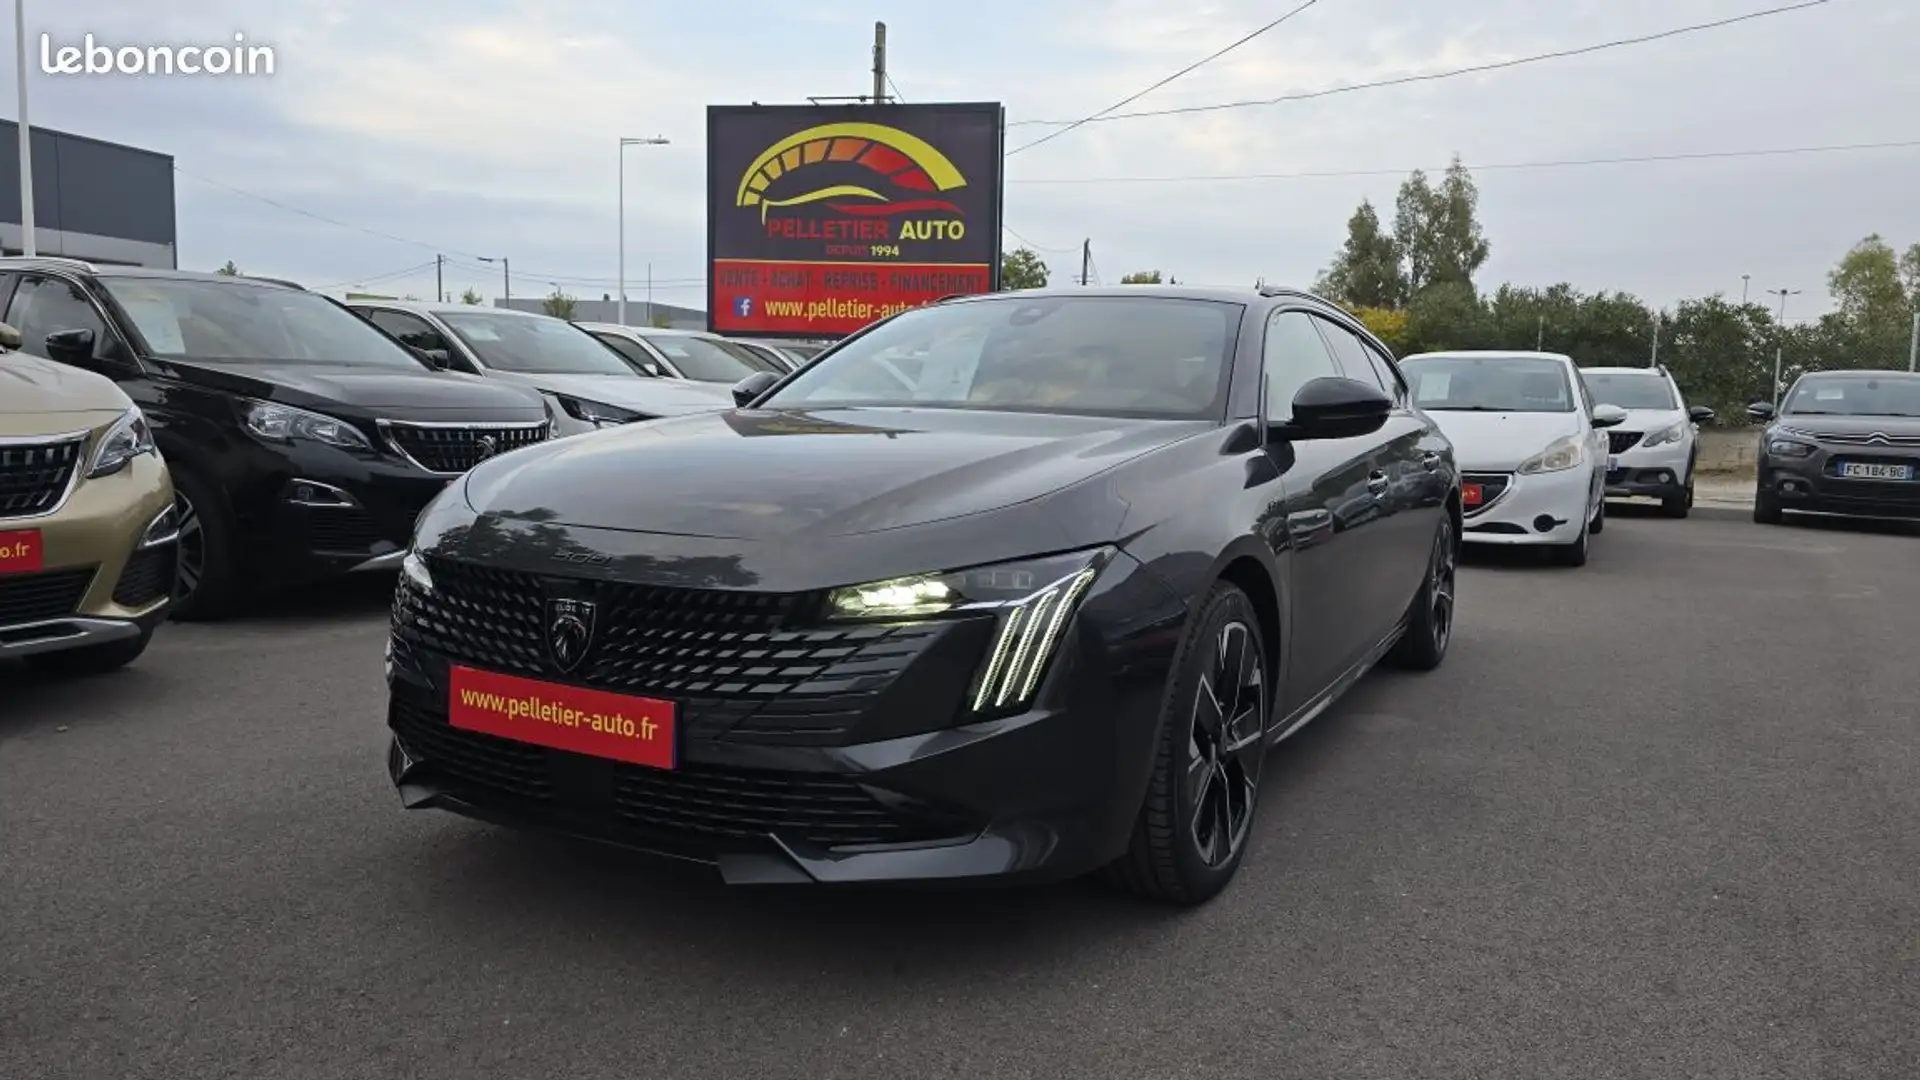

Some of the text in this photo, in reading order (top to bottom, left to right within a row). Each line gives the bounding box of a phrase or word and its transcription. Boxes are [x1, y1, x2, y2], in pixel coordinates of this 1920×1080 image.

[767, 219, 965, 240] PELLETIER AUTO
[871, 245, 899, 256] 1994
[461, 687, 658, 740] www.pelletier-auto.fr
